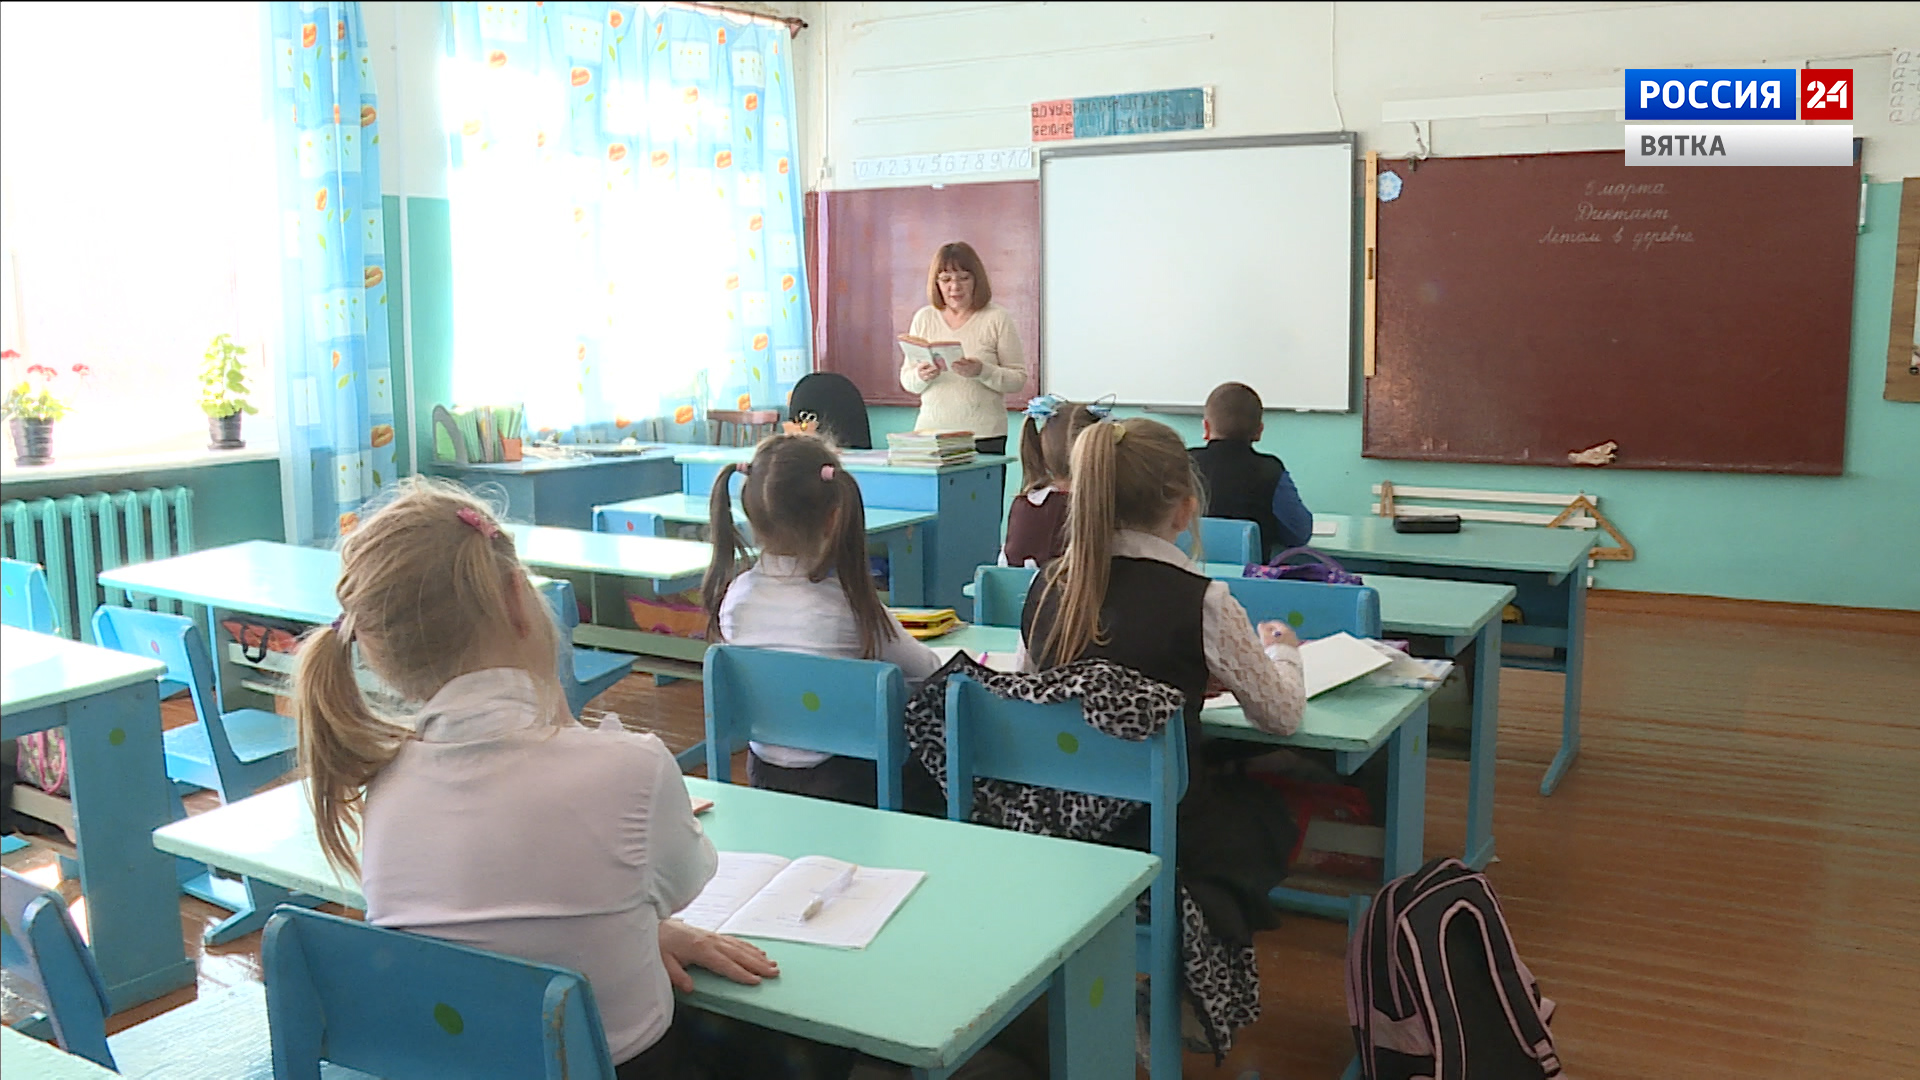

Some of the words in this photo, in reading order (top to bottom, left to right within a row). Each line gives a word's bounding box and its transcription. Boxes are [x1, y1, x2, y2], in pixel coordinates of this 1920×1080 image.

[888, 159, 897, 176] 2
[902, 158, 911, 175] 3
[916, 157, 925, 173] 4
[930, 155, 940, 173] 5
[945, 155, 955, 172] 6
[960, 155, 969, 170] 7
[975, 153, 985, 170] 8
[990, 152, 1000, 169] 9
[1007, 149, 1030, 168] 10
[1598, 182, 1667, 204] марта
[1575, 201, 1671, 222] Диктант
[1538, 225, 1603, 244] Летом
[1611, 225, 1625, 244] в
[1632, 224, 1695, 252] деревне
